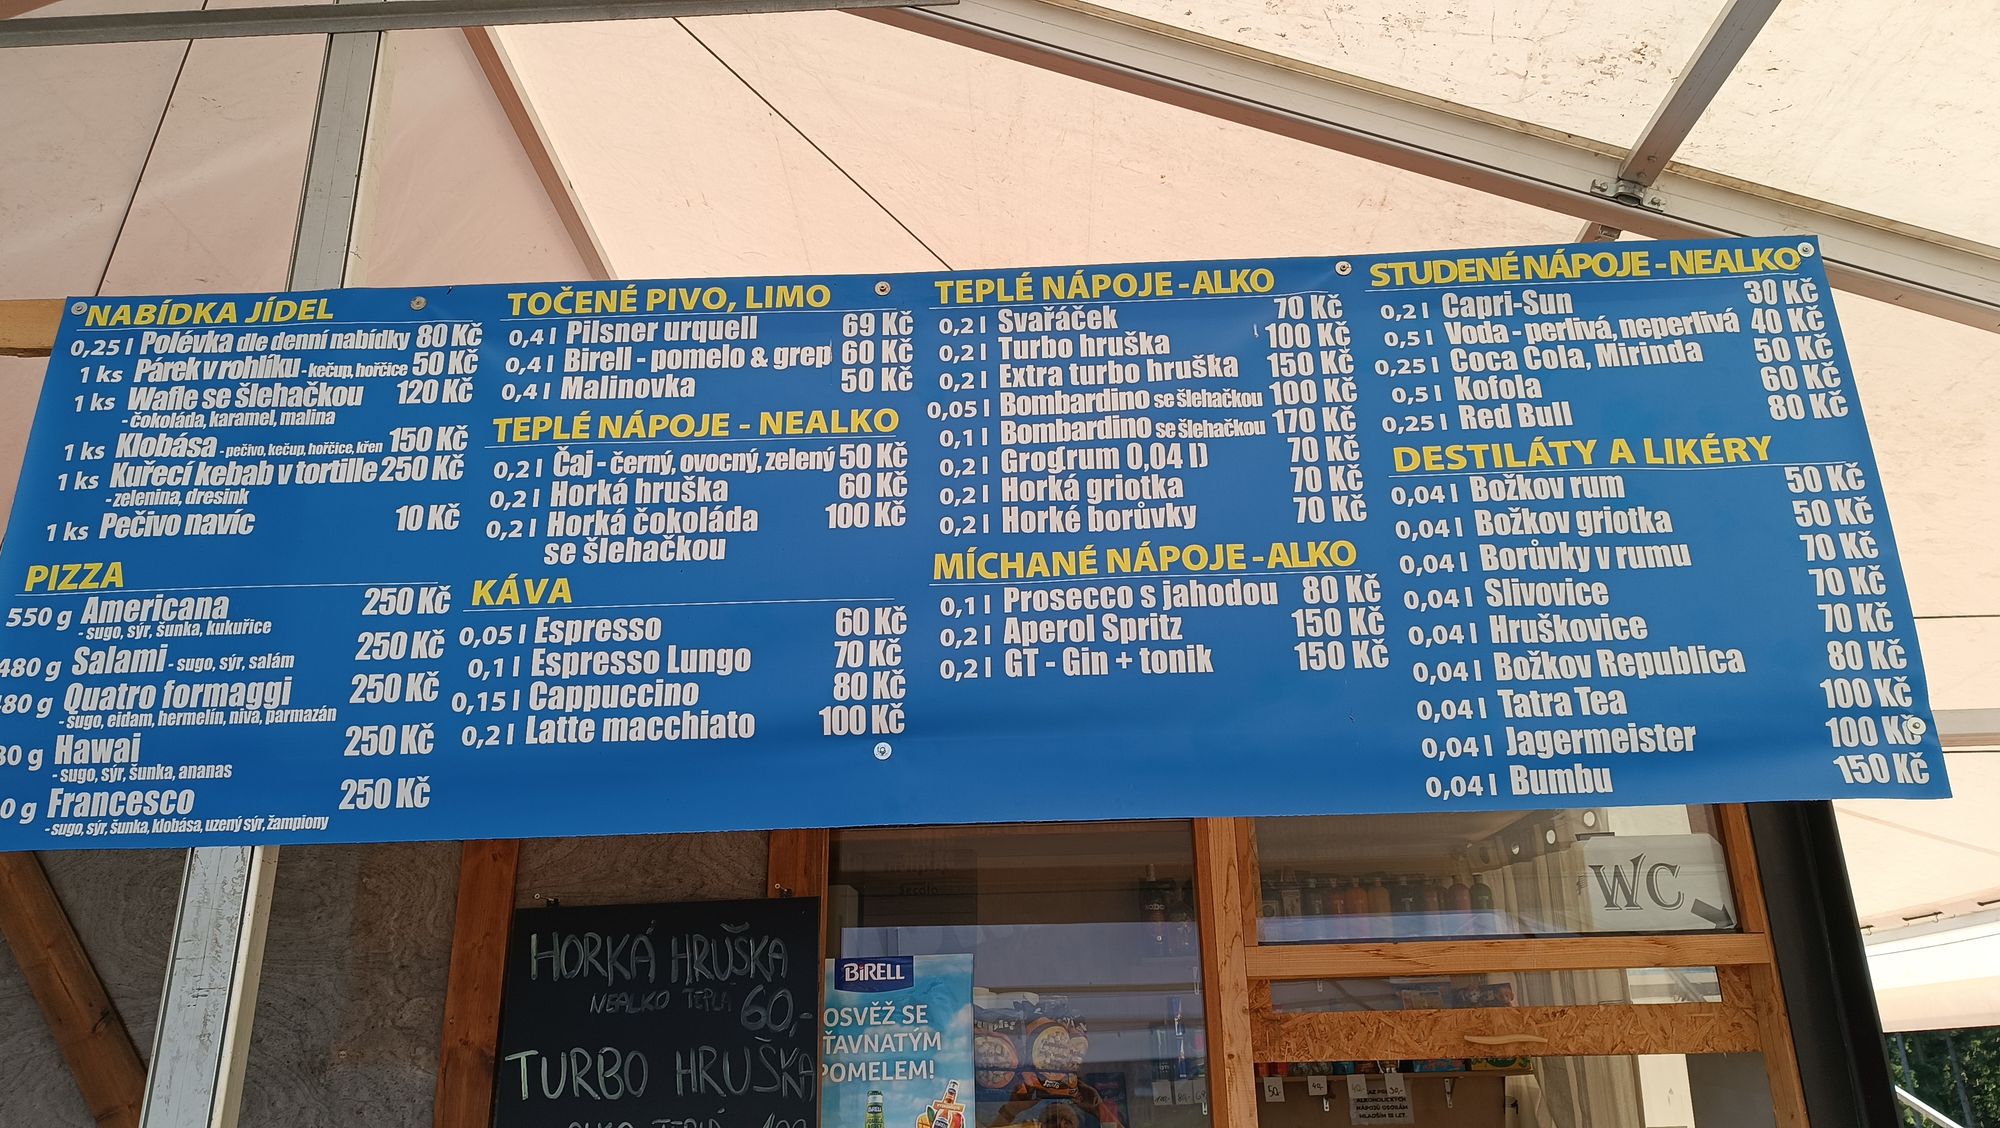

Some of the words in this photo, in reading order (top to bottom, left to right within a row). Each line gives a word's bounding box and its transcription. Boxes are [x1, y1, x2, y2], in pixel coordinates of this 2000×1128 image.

[1369, 255, 1525, 289] STUDENÉ
[1522, 248, 1654, 284] NÁPOJE
[1669, 247, 1802, 277] NEALKO
[507, 283, 638, 318] TOČENÉ
[646, 286, 742, 316] PIVO,
[745, 284, 831, 309] LIMO
[934, 271, 1034, 305] TEPLÉ
[1042, 269, 1174, 301] NÁPOJE
[1191, 267, 1275, 295] ALKO
[84, 298, 242, 328] NABÍDKA
[244, 295, 334, 325] JÍDEL
[938, 317, 974, 337] 0,2
[997, 304, 1119, 334] Svařáček
[1441, 289, 1574, 320] Capri-Sun
[139, 329, 234, 355] Polévka
[236, 332, 269, 353] dle
[270, 331, 329, 352] denní
[329, 328, 411, 351] nabídky
[415, 323, 449, 349] 80
[450, 322, 483, 347] Kč
[566, 319, 659, 345] Pilsner
[663, 315, 758, 344] urquell
[842, 312, 876, 338] 69
[881, 310, 914, 336] Kč
[133, 356, 202, 383] Párek
[202, 360, 219, 381] v
[217, 353, 302, 380] rohlíku
[307, 361, 354, 380] kečup,
[354, 361, 409, 378] hořčice
[563, 346, 633, 373] Birell
[650, 343, 746, 373] pomelo
[750, 346, 769, 369] &
[773, 341, 833, 371] grep
[999, 363, 1064, 389] Extra
[1068, 359, 1141, 386] turbo
[1146, 353, 1239, 383] hruška
[1266, 351, 1315, 378] 150
[1319, 345, 1355, 375] Kč
[1449, 347, 1519, 373] Coca
[1522, 344, 1592, 371] Cola,
[1594, 338, 1704, 368] Mirinda
[1753, 336, 1792, 364] 50
[1794, 331, 1834, 361] Kč
[127, 385, 199, 411] Wafle
[201, 387, 232, 410] se
[234, 380, 365, 409] šlehačkou
[999, 387, 1151, 417] Bombardino
[1153, 392, 1175, 409] se
[1175, 387, 1264, 409] šlehačkou
[129, 411, 207, 430] čokoláda,
[208, 409, 278, 428] karamel,
[279, 408, 336, 426] malina
[115, 431, 218, 459] Klobása
[224, 443, 265, 459] pečivo,
[267, 442, 307, 457] kečup,
[307, 441, 355, 455] hořčice,
[355, 440, 384, 454] křen
[1126, 442, 1184, 473] 0,04
[1392, 435, 1598, 473] DESTILÁTY
[1609, 438, 1637, 465] A
[1643, 432, 1772, 465] LIKÉRY
[109, 459, 196, 489] Kuřecí
[193, 460, 275, 487] kebab
[277, 463, 294, 485] v
[294, 457, 379, 485] tortille
[553, 445, 594, 479] Čaj
[609, 449, 677, 476] černý,
[679, 447, 762, 474] ovocný,
[764, 445, 836, 472] zelený
[112, 489, 183, 508] zelenina,
[184, 487, 250, 505] dresink
[1468, 473, 1565, 503] Božkov
[1569, 475, 1626, 499] rum
[546, 507, 627, 537] Horká
[632, 504, 759, 535] čokoláda
[1001, 504, 1081, 534] Horké
[1087, 500, 1197, 533] borůvky
[24, 561, 124, 593] PIZZA
[933, 544, 1104, 582] MÍCHANÉ
[1106, 540, 1247, 574] NÁPOJE
[1266, 539, 1357, 569] ALKO
[471, 572, 573, 606] KÁVA
[1003, 585, 1134, 614] Prosecco
[1139, 584, 1157, 609] s
[1162, 578, 1279, 611] jahodou
[1484, 577, 1610, 608] Slivovice
[5, 607, 53, 628] 550
[56, 610, 73, 631] g
[80, 593, 230, 626] Americana
[361, 586, 415, 616] 250
[416, 584, 452, 615] Kč
[85, 626, 124, 641] sugo,
[126, 621, 153, 640] sýr,
[155, 620, 203, 638] šunka,
[205, 618, 272, 636] kukuřice
[458, 625, 513, 649] 0,05
[534, 616, 662, 646] Espresso
[1003, 613, 1096, 647] Aperol
[1101, 612, 1184, 645] Spritz
[71, 643, 169, 676] Salami
[176, 657, 216, 673] sugo,
[219, 653, 246, 672] sýr,
[248, 652, 295, 670] salám
[529, 678, 700, 713] Cappuccino
[833, 671, 868, 702] 80
[872, 668, 906, 700] Kč
[1496, 688, 1574, 719] Tatra
[1574, 686, 1628, 716] Tea
[65, 714, 105, 731] sugo,
[106, 711, 155, 728] eidam,
[157, 708, 227, 727] hermelín,
[228, 707, 263, 726] niva,
[264, 704, 337, 725] parmazán
[54, 732, 142, 765] Hawai
[1505, 722, 1697, 759] Jagermeister
[1509, 763, 1614, 796] Bumbu
[1832, 752, 1891, 784] 150
[1891, 751, 1930, 785] Kč
[46, 787, 195, 821] Francesco
[50, 822, 85, 837] sugo,
[85, 819, 108, 837] sýr,
[109, 818, 150, 835] šunka,
[151, 817, 204, 834] klobása,
[204, 815, 243, 833] uzený
[242, 815, 266, 832] sýr,
[266, 814, 330, 832] žampiony
[1588, 852, 1685, 910] WC
[531, 920, 656, 987] HORKÁ
[670, 922, 788, 986] HRUŠKA
[590, 991, 670, 1015] NEALKO
[824, 1001, 896, 1027] OSVĚŽ
[902, 1005, 928, 1024] SE
[823, 1027, 941, 1054] ŤAVNATÝM
[505, 1046, 649, 1101] TURBO
[675, 1036, 815, 1102] HRUŠKA
